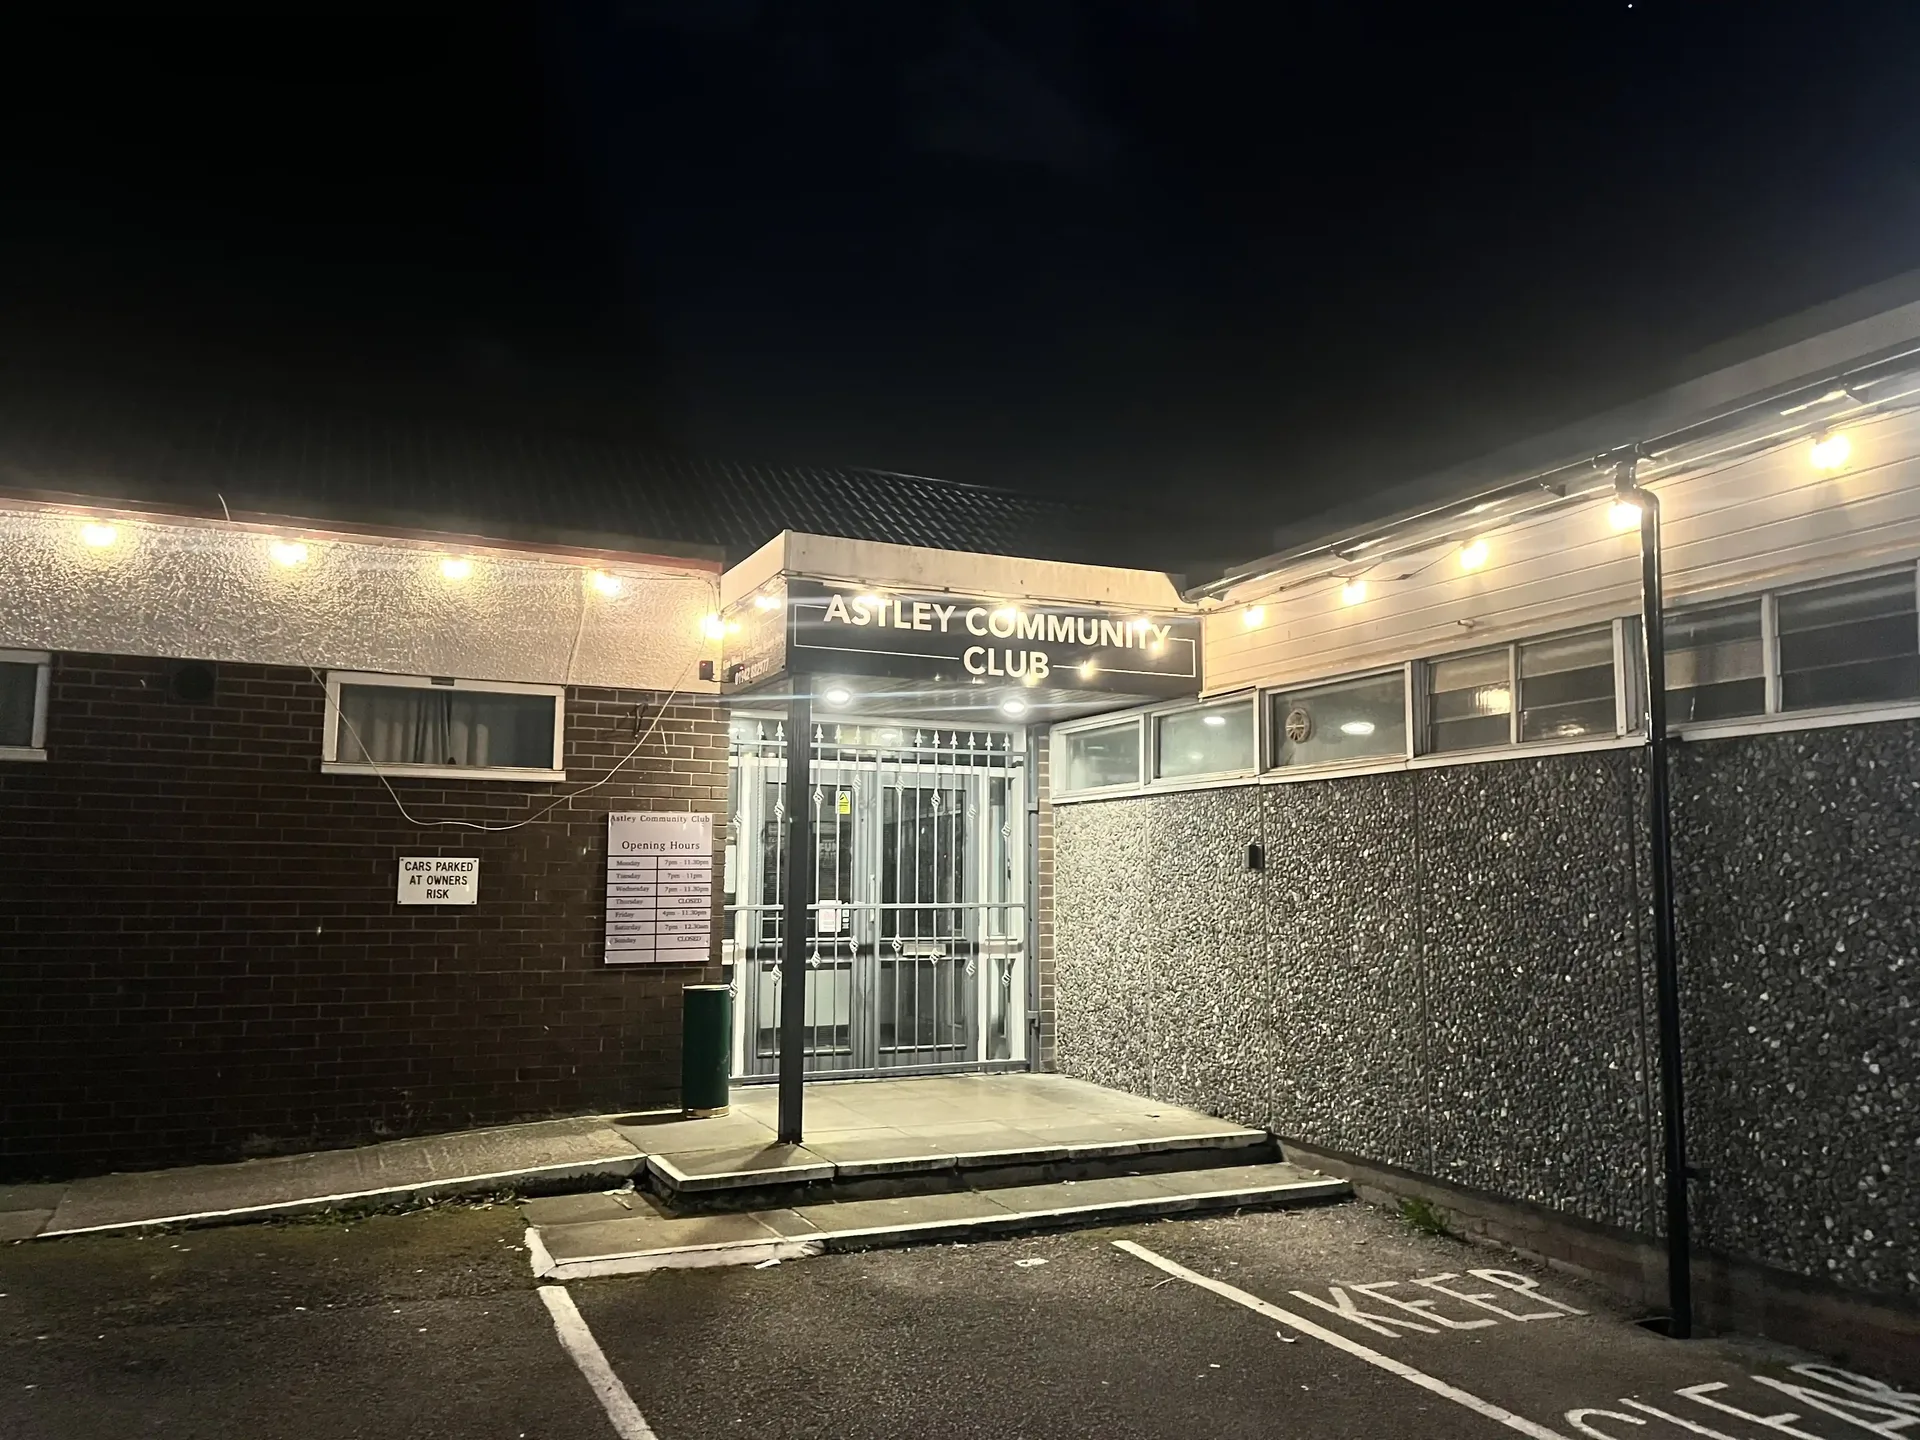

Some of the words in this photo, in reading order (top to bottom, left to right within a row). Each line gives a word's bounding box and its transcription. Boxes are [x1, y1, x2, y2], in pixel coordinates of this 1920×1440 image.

[823, 594, 957, 633] ASTLEY
[965, 606, 1172, 650] COMMUNITY
[963, 646, 1050, 679] CLUB
[611, 815, 636, 823] Astley
[640, 815, 687, 824] Community
[691, 815, 710, 823] Club
[622, 841, 666, 851] Opening
[670, 841, 700, 850] Hours
[404, 861, 432, 872] CARS
[435, 861, 473, 872] PARKED
[409, 875, 423, 885] AT
[426, 875, 468, 886] OWNERS
[426, 889, 450, 899] RISK
[1288, 1268, 1591, 1338] KEEP
